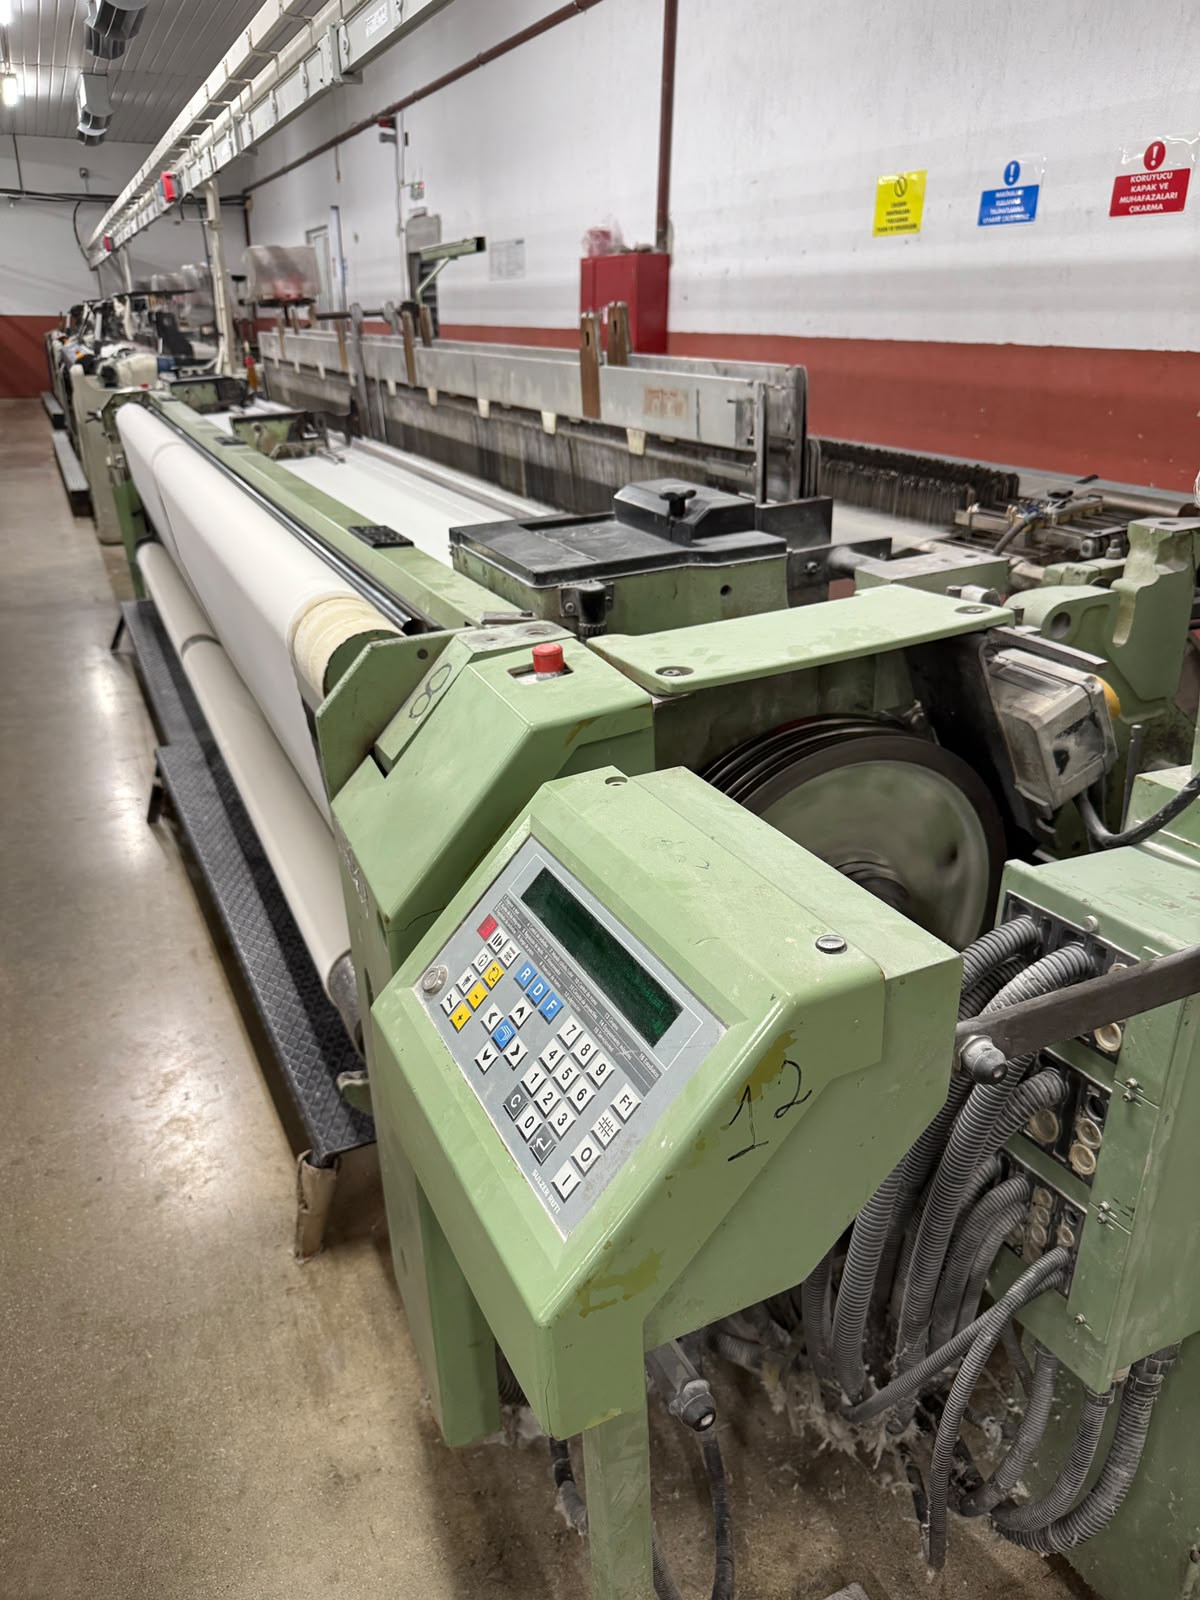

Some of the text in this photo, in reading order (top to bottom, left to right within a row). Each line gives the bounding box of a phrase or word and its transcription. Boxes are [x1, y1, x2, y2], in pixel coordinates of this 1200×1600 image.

[1130, 172, 1173, 183] KORUYUCU
[1130, 182, 1169, 193] KAPAK VE
[1119, 192, 1178, 204] MUHAFAZALARI
[1128, 203, 1163, 213] ÇIKARMA
[520, 967, 531, 981] R
[532, 984, 543, 996] D
[545, 999, 557, 1011] F
[566, 1024, 577, 1036] 7
[548, 1049, 559, 1061] 4
[580, 1043, 591, 1056] 8
[561, 1067, 573, 1080] 5
[595, 1063, 607, 1077] 9
[530, 1072, 540, 1084] 1
[510, 1094, 521, 1108] C
[542, 1091, 554, 1105] 2
[576, 1088, 588, 1102] 6
[619, 1094, 634, 1112] F1
[727, 1059, 813, 1162] 12
[557, 1112, 568, 1126] 3
[531, 1169, 550, 1197] SULZER
